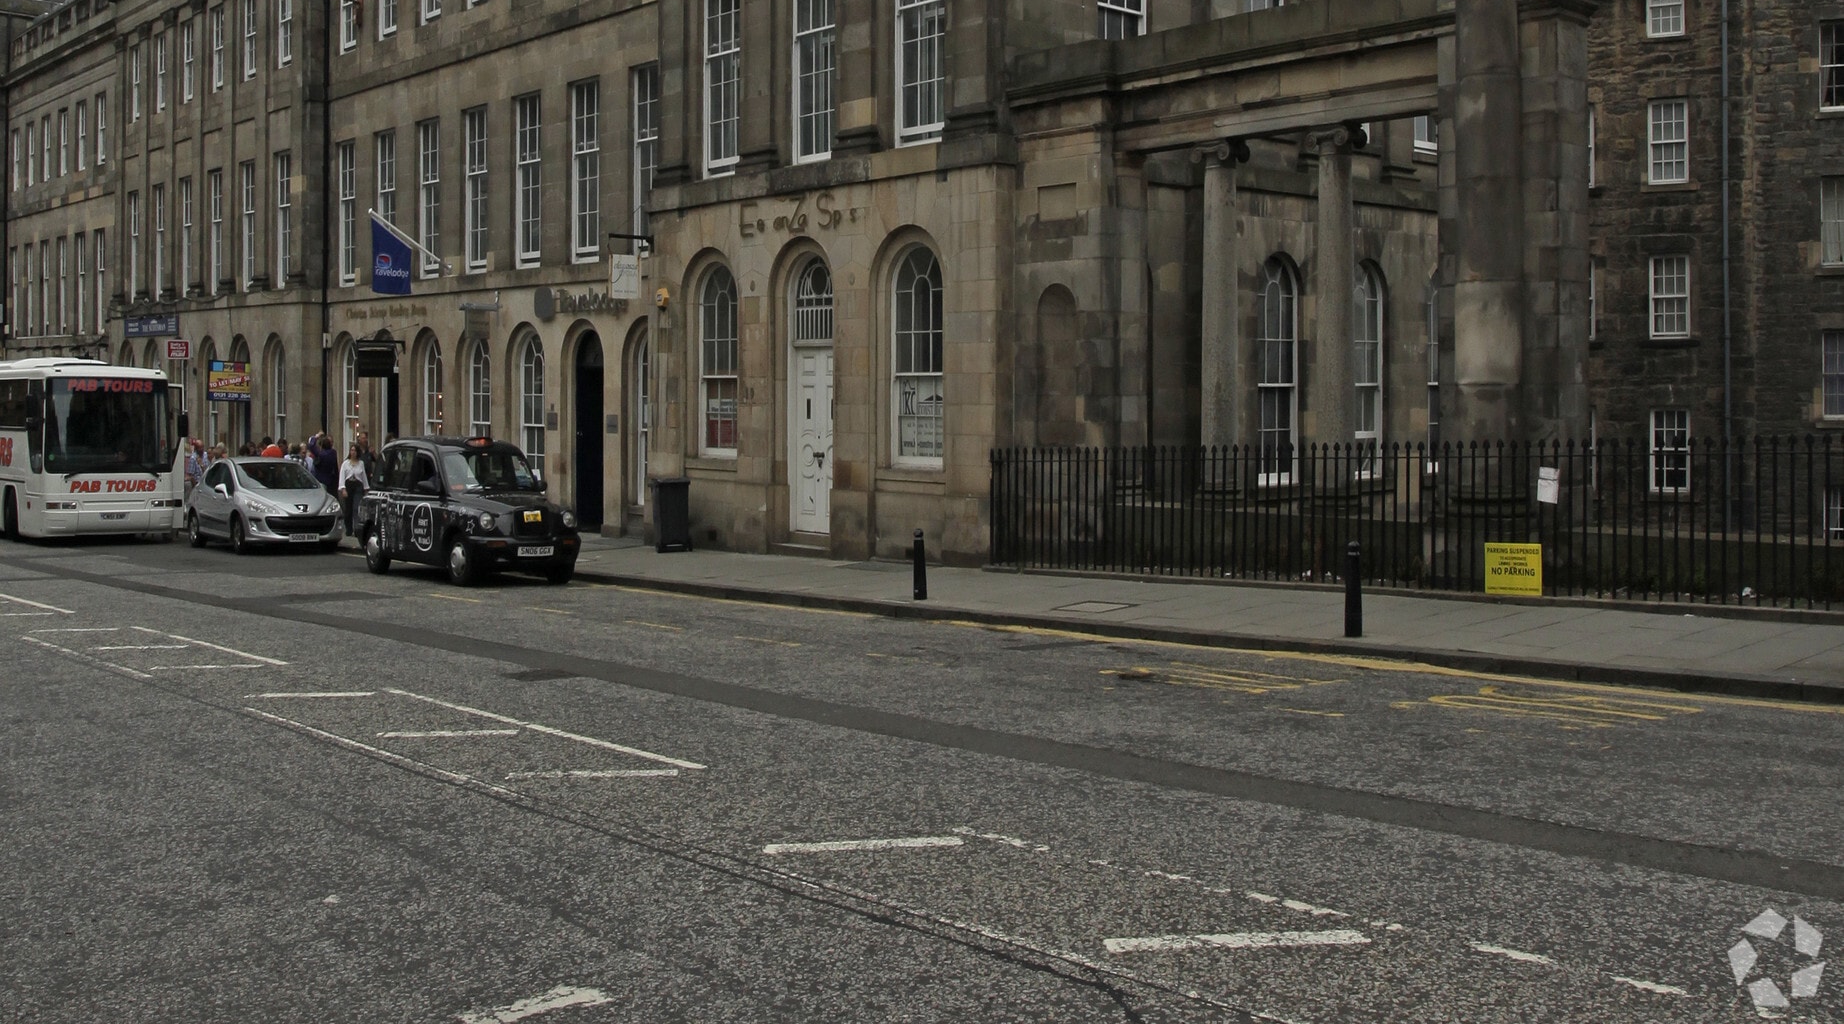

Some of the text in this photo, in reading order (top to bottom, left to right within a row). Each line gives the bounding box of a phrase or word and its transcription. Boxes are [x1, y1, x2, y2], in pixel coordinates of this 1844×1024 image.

[67, 379, 153, 393] PAB TOURS
[70, 479, 157, 493] PAB TOURS
[1509, 547, 1539, 555] SUSPENDED
[1491, 567, 1535, 577] NO PARKING
